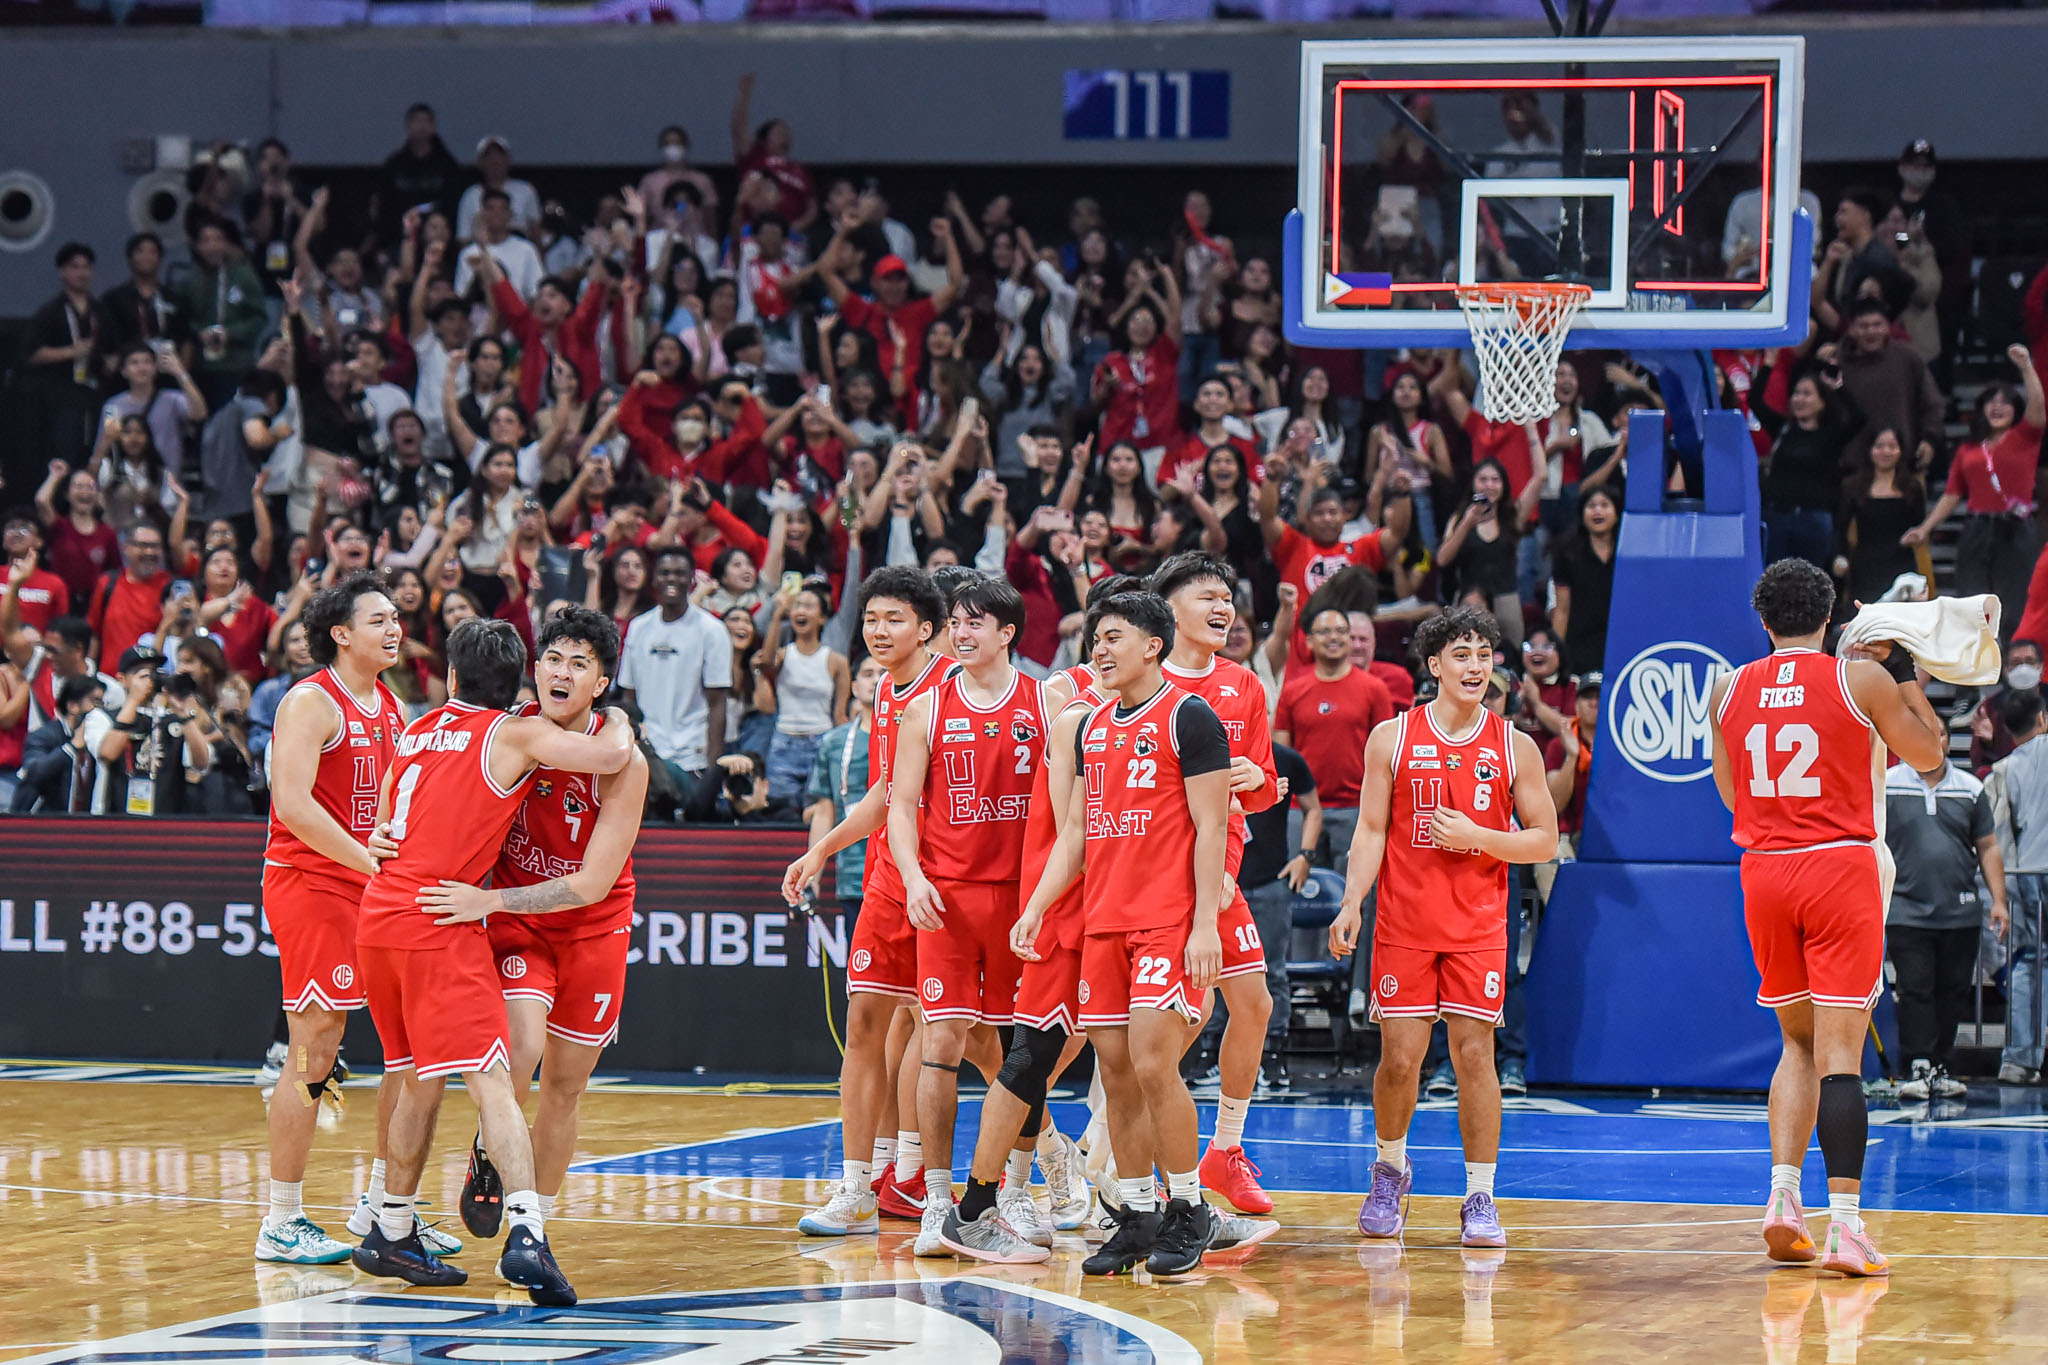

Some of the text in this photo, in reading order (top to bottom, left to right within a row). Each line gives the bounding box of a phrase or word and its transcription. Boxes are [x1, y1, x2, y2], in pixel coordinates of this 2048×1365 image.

[1103, 72, 1191, 137] 111
[1621, 657, 1726, 763] SM
[1758, 685, 1805, 709] FIKES
[353, 755, 378, 794] U
[943, 749, 975, 788] U
[1014, 745, 1031, 775] 2
[1126, 758, 1158, 789] 22
[1745, 723, 1822, 798] 12
[1084, 763, 1106, 801] U
[1411, 777, 1442, 813] U
[1473, 783, 1493, 812] 6
[389, 762, 423, 841] 1
[564, 814, 581, 842] 7
[1086, 801, 1153, 840] EAST
[1234, 923, 1261, 952] 10
[1136, 956, 1171, 986] 22
[1484, 970, 1500, 999] 6
[593, 993, 612, 1023] 7
